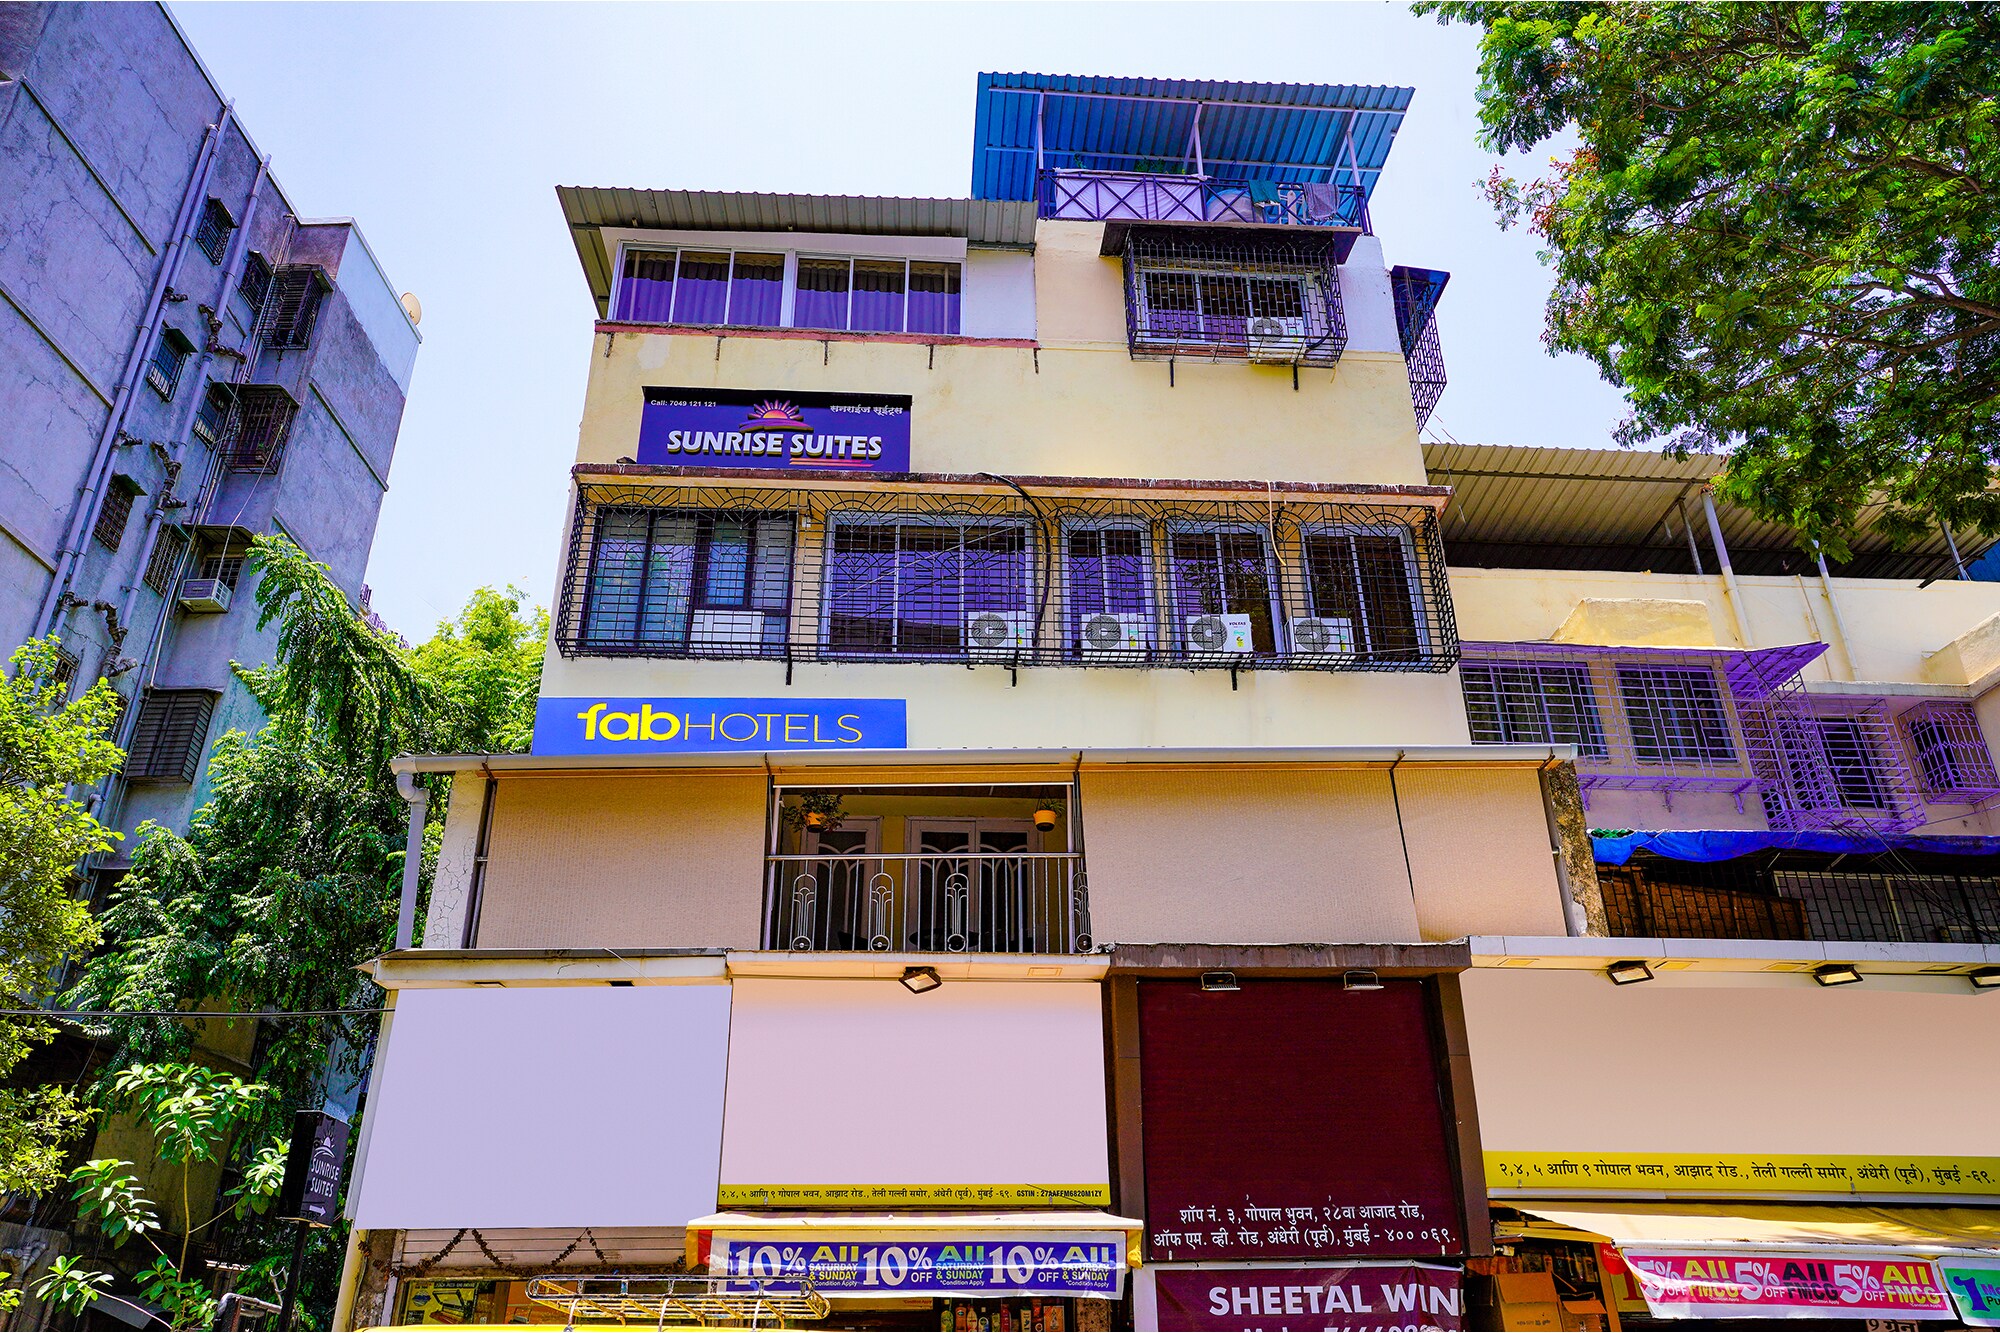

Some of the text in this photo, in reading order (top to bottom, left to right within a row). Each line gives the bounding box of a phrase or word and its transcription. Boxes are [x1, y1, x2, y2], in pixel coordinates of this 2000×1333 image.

[666, 430, 883, 457] SUNRISE SUITES
[311, 1158, 340, 1181] SUNRISE
[1547, 1160, 1578, 1176] आणि
[1582, 1164, 1592, 1177] ९
[1594, 1159, 1632, 1177] गोपाल
[1636, 1164, 1670, 1179] भवन,
[1674, 1165, 1714, 1178] आझाद
[1751, 1161, 1777, 1178] तेली
[1779, 1163, 1813, 1179] गल्ली
[1815, 1163, 1853, 1181] समोर,
[1857, 1164, 1891, 1180] अंधेरी
[1894, 1164, 1931, 1185] (पूर्व),
[1932, 1165, 1962, 1185] मुंबई
[310, 1177, 334, 1198] SUITES
[750, 1188, 769, 1198] आणि
[771, 1190, 776, 1199] ९
[778, 1188, 800, 1198] गोपाल
[803, 1190, 822, 1199] भवन,
[825, 1190, 848, 1198] आझाद
[872, 1188, 886, 1198] तेली
[888, 1189, 907, 1198] गल्ली
[909, 1188, 930, 1199] समोर,
[933, 1188, 953, 1198] अंधेरी
[954, 1188, 975, 1200] (पूर्व),
[977, 1188, 994, 1200] मुंबई
[1016, 1190, 1036, 1198] GSTIN
[1180, 1205, 1204, 1224] शॉप
[1207, 1205, 1221, 1222] नं.
[1227, 1208, 1241, 1224] ३,
[1244, 1203, 1282, 1222] गोपाल
[1285, 1206, 1318, 1225] भुवन,
[1359, 1205, 1397, 1219] आजाद
[1398, 1200, 1425, 1220] रोड,
[1154, 1229, 1181, 1246] ऑफ
[1185, 1232, 1207, 1250] एम.
[1211, 1227, 1234, 1247] व्ही.
[1237, 1226, 1263, 1247] रोड,
[1267, 1226, 1299, 1244] अंधेरी
[1304, 1224, 1340, 1248] (पूर्व),
[1343, 1223, 1371, 1247] मुंबई
[1385, 1228, 1414, 1242] ४००
[1421, 1228, 1456, 1243] ०६९.
[735, 1245, 859, 1286] 10% All
[809, 1263, 858, 1272] SATURDAY
[862, 1246, 985, 1286] 10% All
[936, 1262, 984, 1271] SATURDAY
[989, 1245, 1110, 1285] 10% All
[1684, 1260, 1730, 1279] All
[784, 1272, 807, 1284] OFF
[809, 1271, 857, 1281] & SUNDAY
[911, 1272, 932, 1283] OFF
[936, 1270, 984, 1280] & SUNDAY
[1037, 1272, 1059, 1283] OFF
[1062, 1271, 1109, 1281] & SUNDAY
[1734, 1261, 1829, 1300] 5% All
[1833, 1264, 1930, 1304] 5% All
[1208, 1284, 1373, 1316] SHEETAL
[1667, 1285, 1687, 1296] OFF
[1764, 1287, 1785, 1298] OFF
[1783, 1282, 1839, 1301] FMCG
[1864, 1290, 1885, 1301] OFF
[1883, 1285, 1941, 1305] FMCG
[1953, 1276, 1990, 1312] 1
